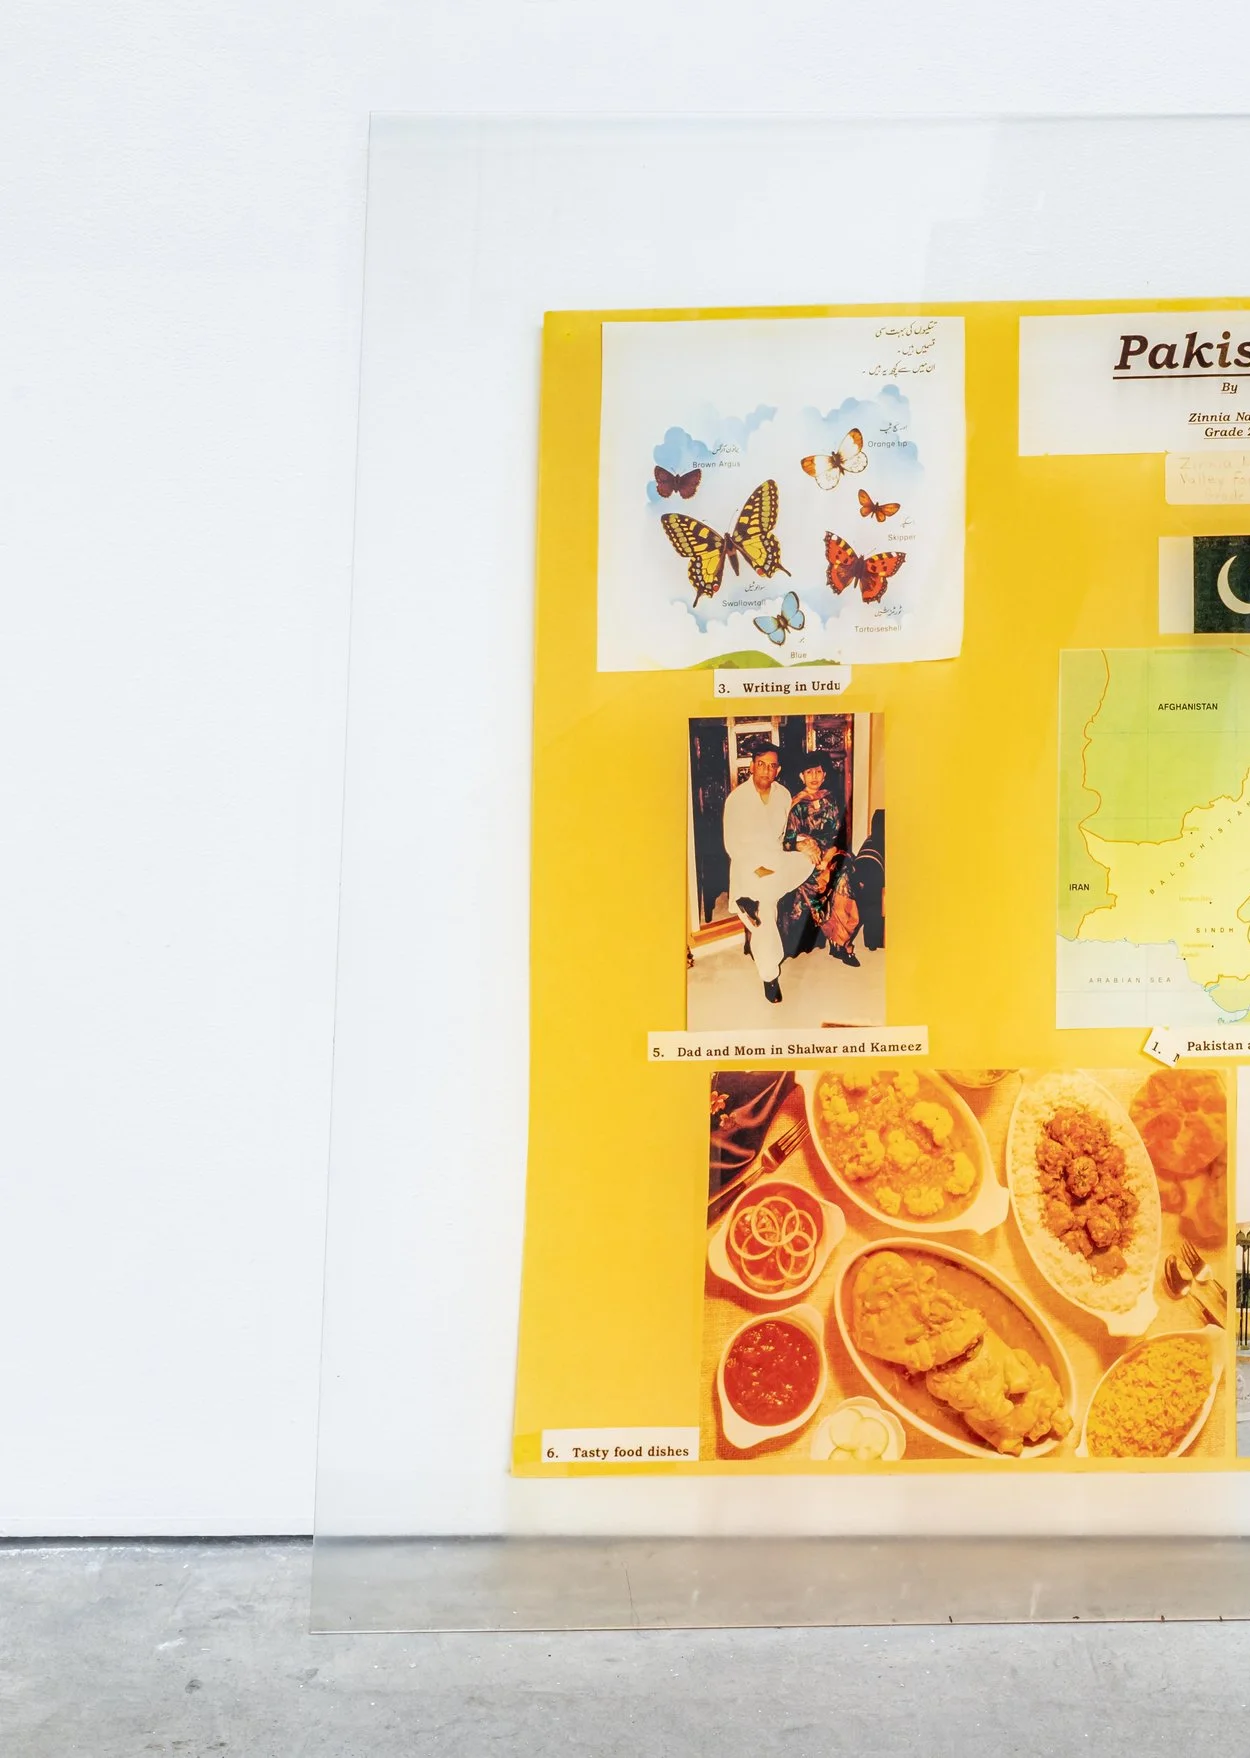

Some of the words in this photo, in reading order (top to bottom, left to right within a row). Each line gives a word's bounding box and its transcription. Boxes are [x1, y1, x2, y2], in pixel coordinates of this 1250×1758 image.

[1220, 382, 1238, 394] By
[1188, 412, 1230, 422] Zinnia
[1204, 426, 1243, 437] Grade
[868, 440, 896, 448] Orange
[898, 440, 907, 448] tip
[719, 460, 740, 468] Argus
[718, 684, 730, 693] 3.
[743, 682, 790, 694] Writing
[795, 681, 807, 691] in
[812, 680, 840, 690] Urdu
[653, 1048, 664, 1057] 5.
[677, 1047, 701, 1057] Dad
[706, 1047, 729, 1056] and
[734, 1046, 766, 1056] Mom
[770, 1045, 783, 1055] in
[787, 1044, 837, 1054] Shalwar
[842, 1044, 865, 1053] and
[871, 1042, 922, 1052] Kameez
[1152, 1042, 1161, 1054] 1.
[1187, 1040, 1243, 1051] Pakistan
[547, 1448, 559, 1458] 6.
[572, 1448, 609, 1460] Tasty
[614, 1446, 642, 1457] food
[648, 1446, 689, 1456] dishes
